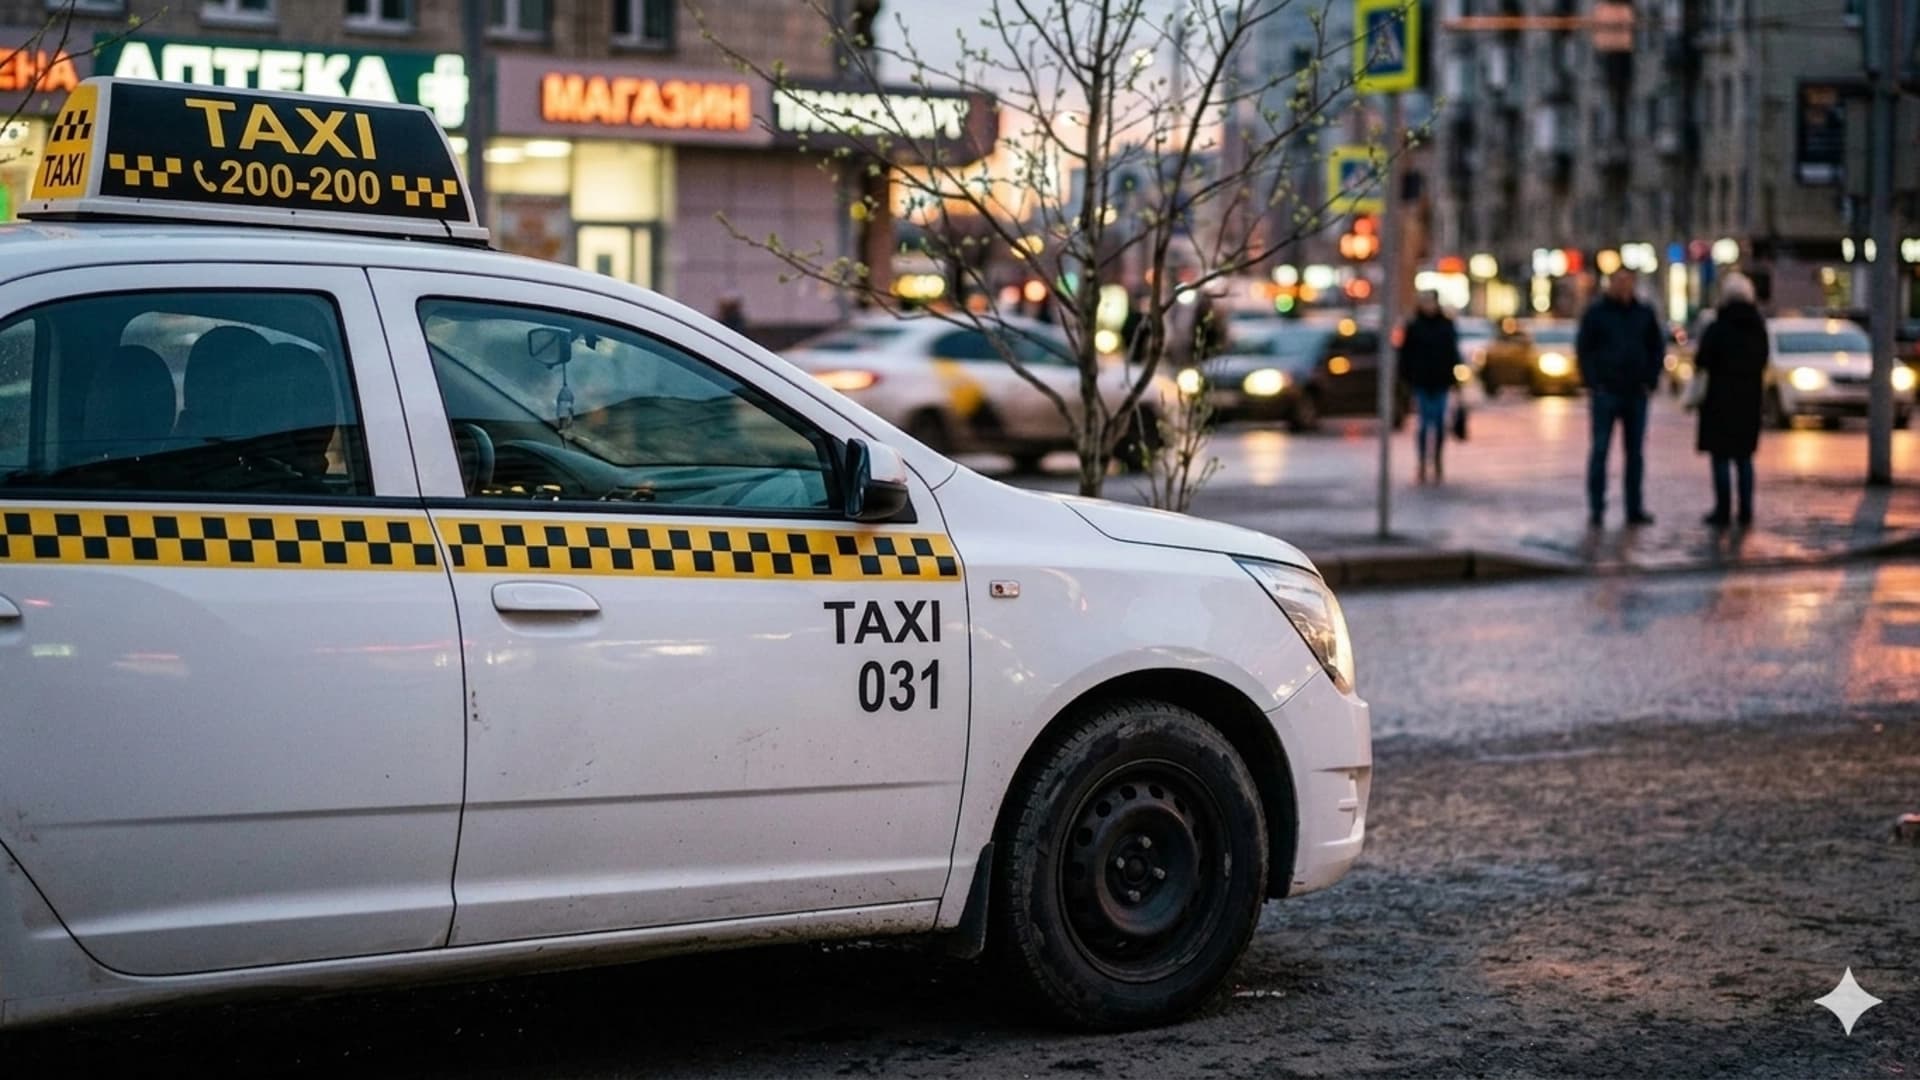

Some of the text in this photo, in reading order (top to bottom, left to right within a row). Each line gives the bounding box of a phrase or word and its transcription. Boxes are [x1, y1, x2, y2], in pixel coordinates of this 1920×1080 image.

[113, 41, 399, 104] АПТЕКА
[543, 72, 751, 132] МАГАЗИН
[185, 98, 376, 160] TAXI
[43, 152, 85, 187] TAXI
[220, 159, 381, 205] 200-200
[823, 600, 941, 644] TAXI
[858, 659, 939, 712] 031
